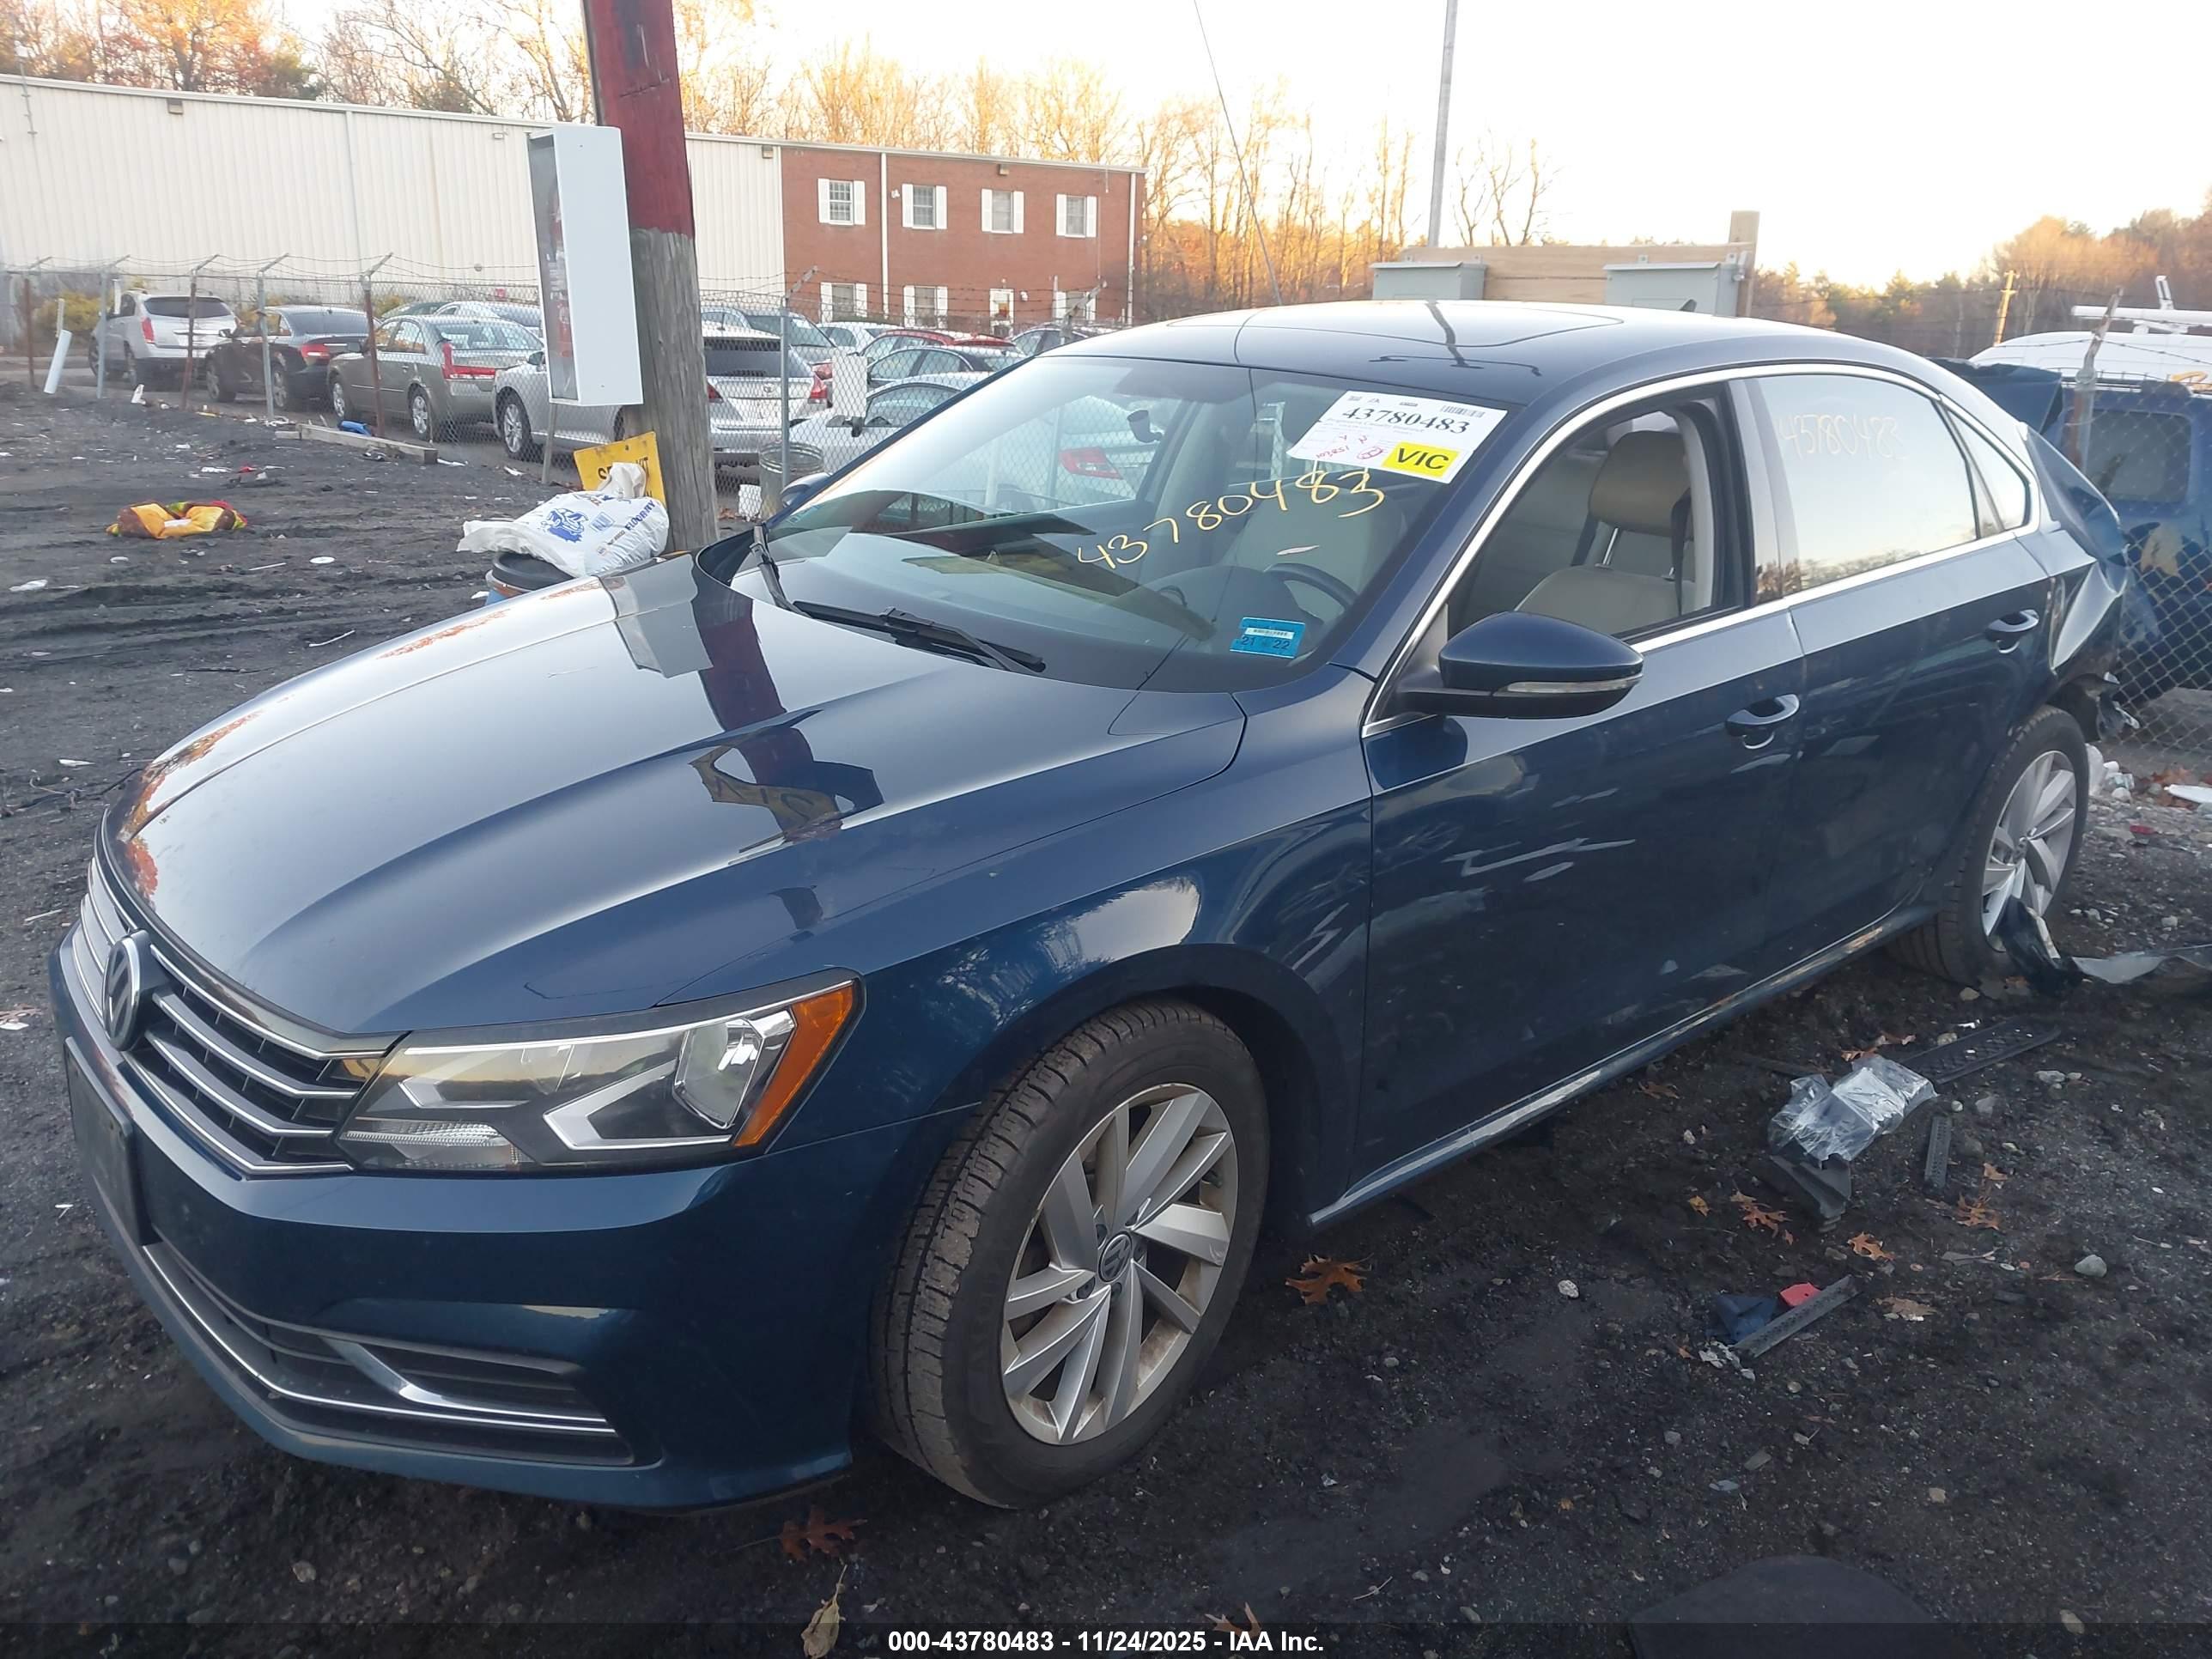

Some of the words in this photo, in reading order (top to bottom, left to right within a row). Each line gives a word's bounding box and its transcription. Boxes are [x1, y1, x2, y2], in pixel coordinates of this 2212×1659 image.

[1342, 406, 1471, 434] 43780483
[1397, 447, 1449, 471] VIC
[1078, 470, 1385, 569] 43780483
[1273, 639, 1291, 650] 22
